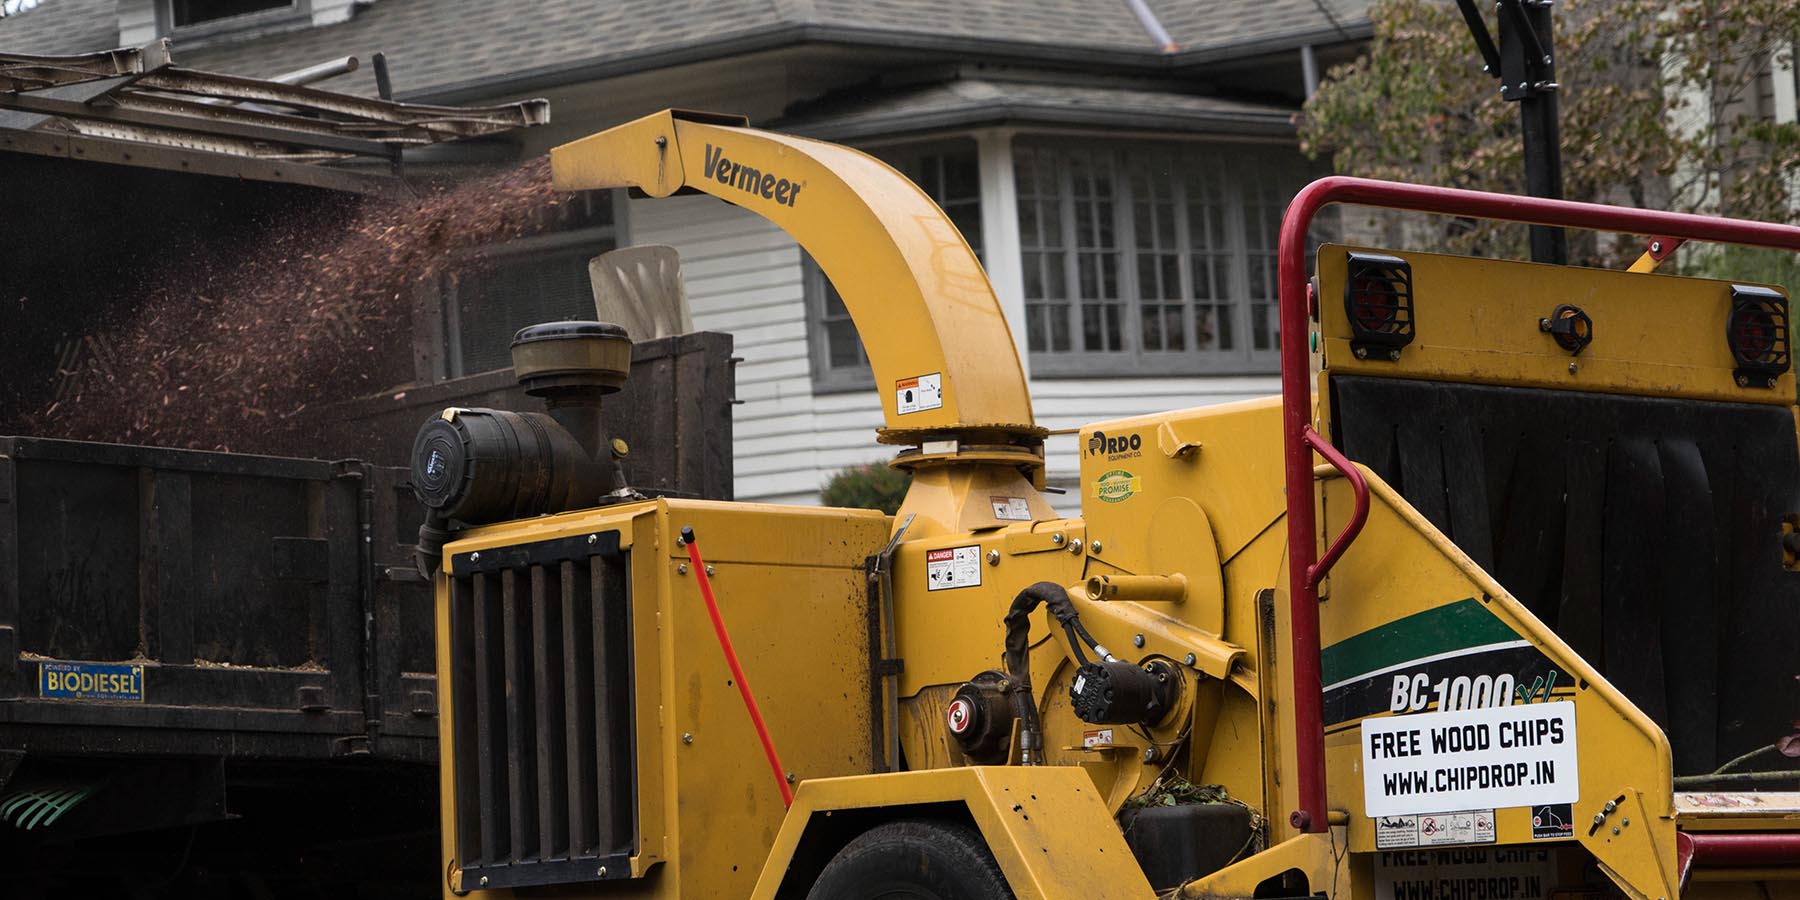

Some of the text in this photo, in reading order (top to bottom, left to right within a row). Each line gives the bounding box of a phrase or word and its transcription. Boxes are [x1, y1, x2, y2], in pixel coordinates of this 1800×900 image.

[704, 143, 802, 208] Vermeer
[1099, 484, 1130, 494] PROMISE
[933, 551, 953, 560] DANGER
[48, 672, 138, 693] BIODIESEL
[1370, 717, 1564, 760] FREE WOOD CHIPS
[1384, 760, 1555, 796] WWW.CHIPDROP.IN
[1393, 875, 1542, 900] WWW.CHIPDROP.IN
